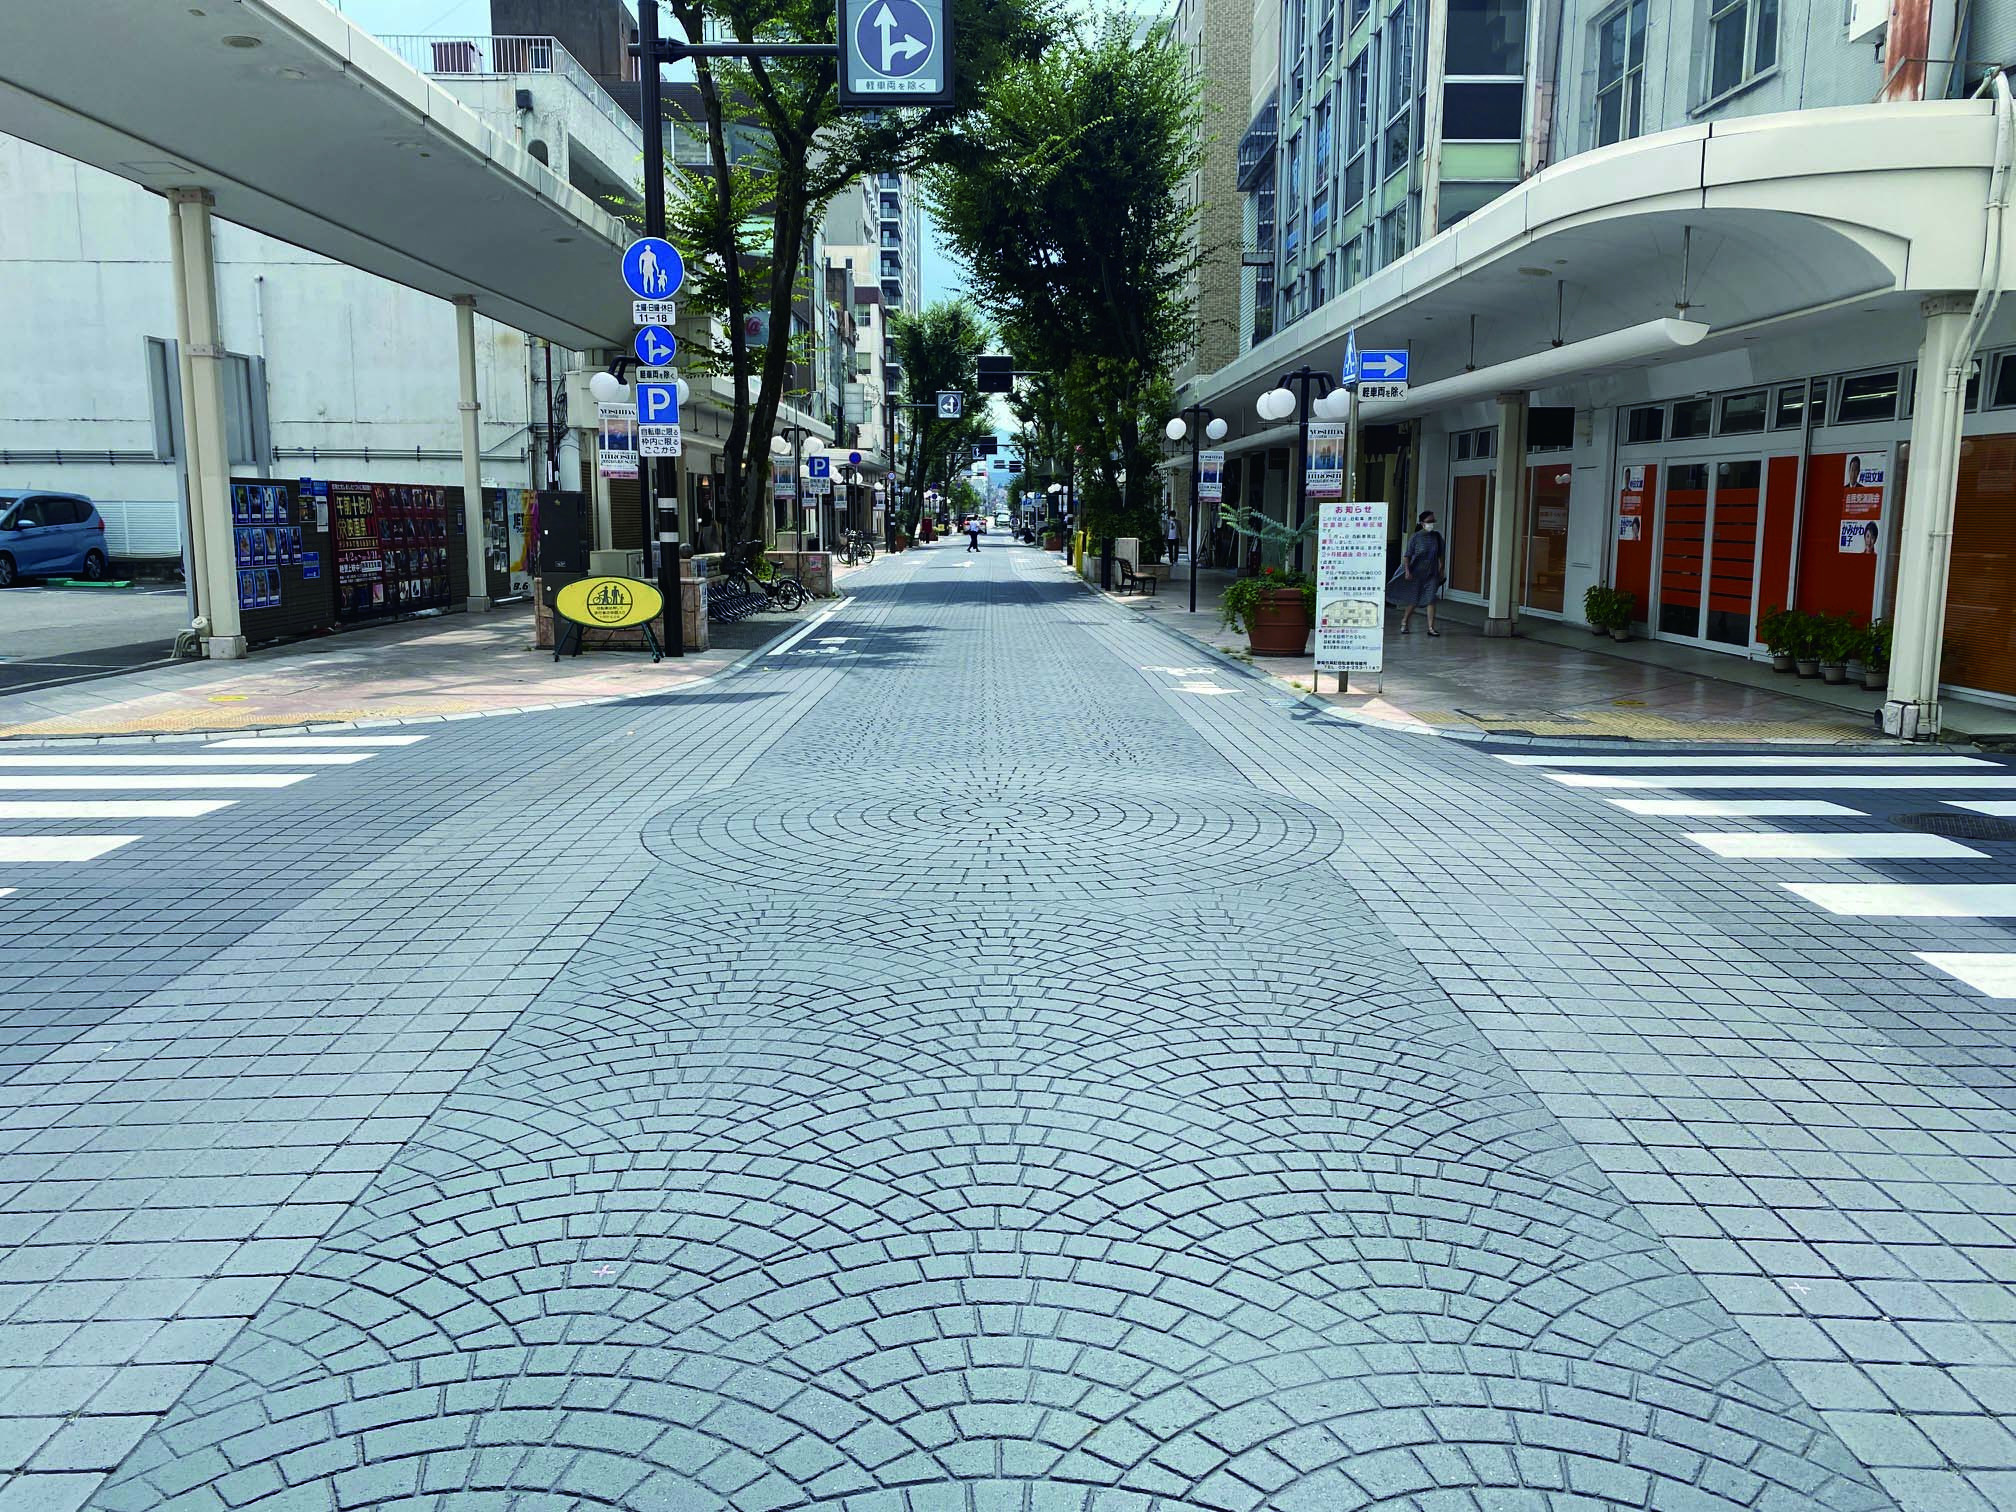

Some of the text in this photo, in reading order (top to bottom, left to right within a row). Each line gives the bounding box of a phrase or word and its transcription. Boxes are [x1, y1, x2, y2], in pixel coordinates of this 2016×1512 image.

[866, 80, 926, 91] 軽車両を除く
[640, 313, 668, 323] 11-18
[640, 370, 675, 379] 軽車両を除く
[1362, 386, 1404, 398] 軽車両を除く
[647, 387, 671, 420] P
[600, 408, 636, 416] YOSHIDA
[640, 427, 679, 436] 自転車に限る
[641, 437, 679, 446] 枠内に限る
[644, 446, 677, 454] ここから
[814, 458, 826, 476] P
[1859, 470, 1884, 483] 岸田文雄
[1335, 505, 1372, 514] お知らせ
[1841, 524, 1865, 536] かみかわ
[513, 582, 529, 591] 8.6
